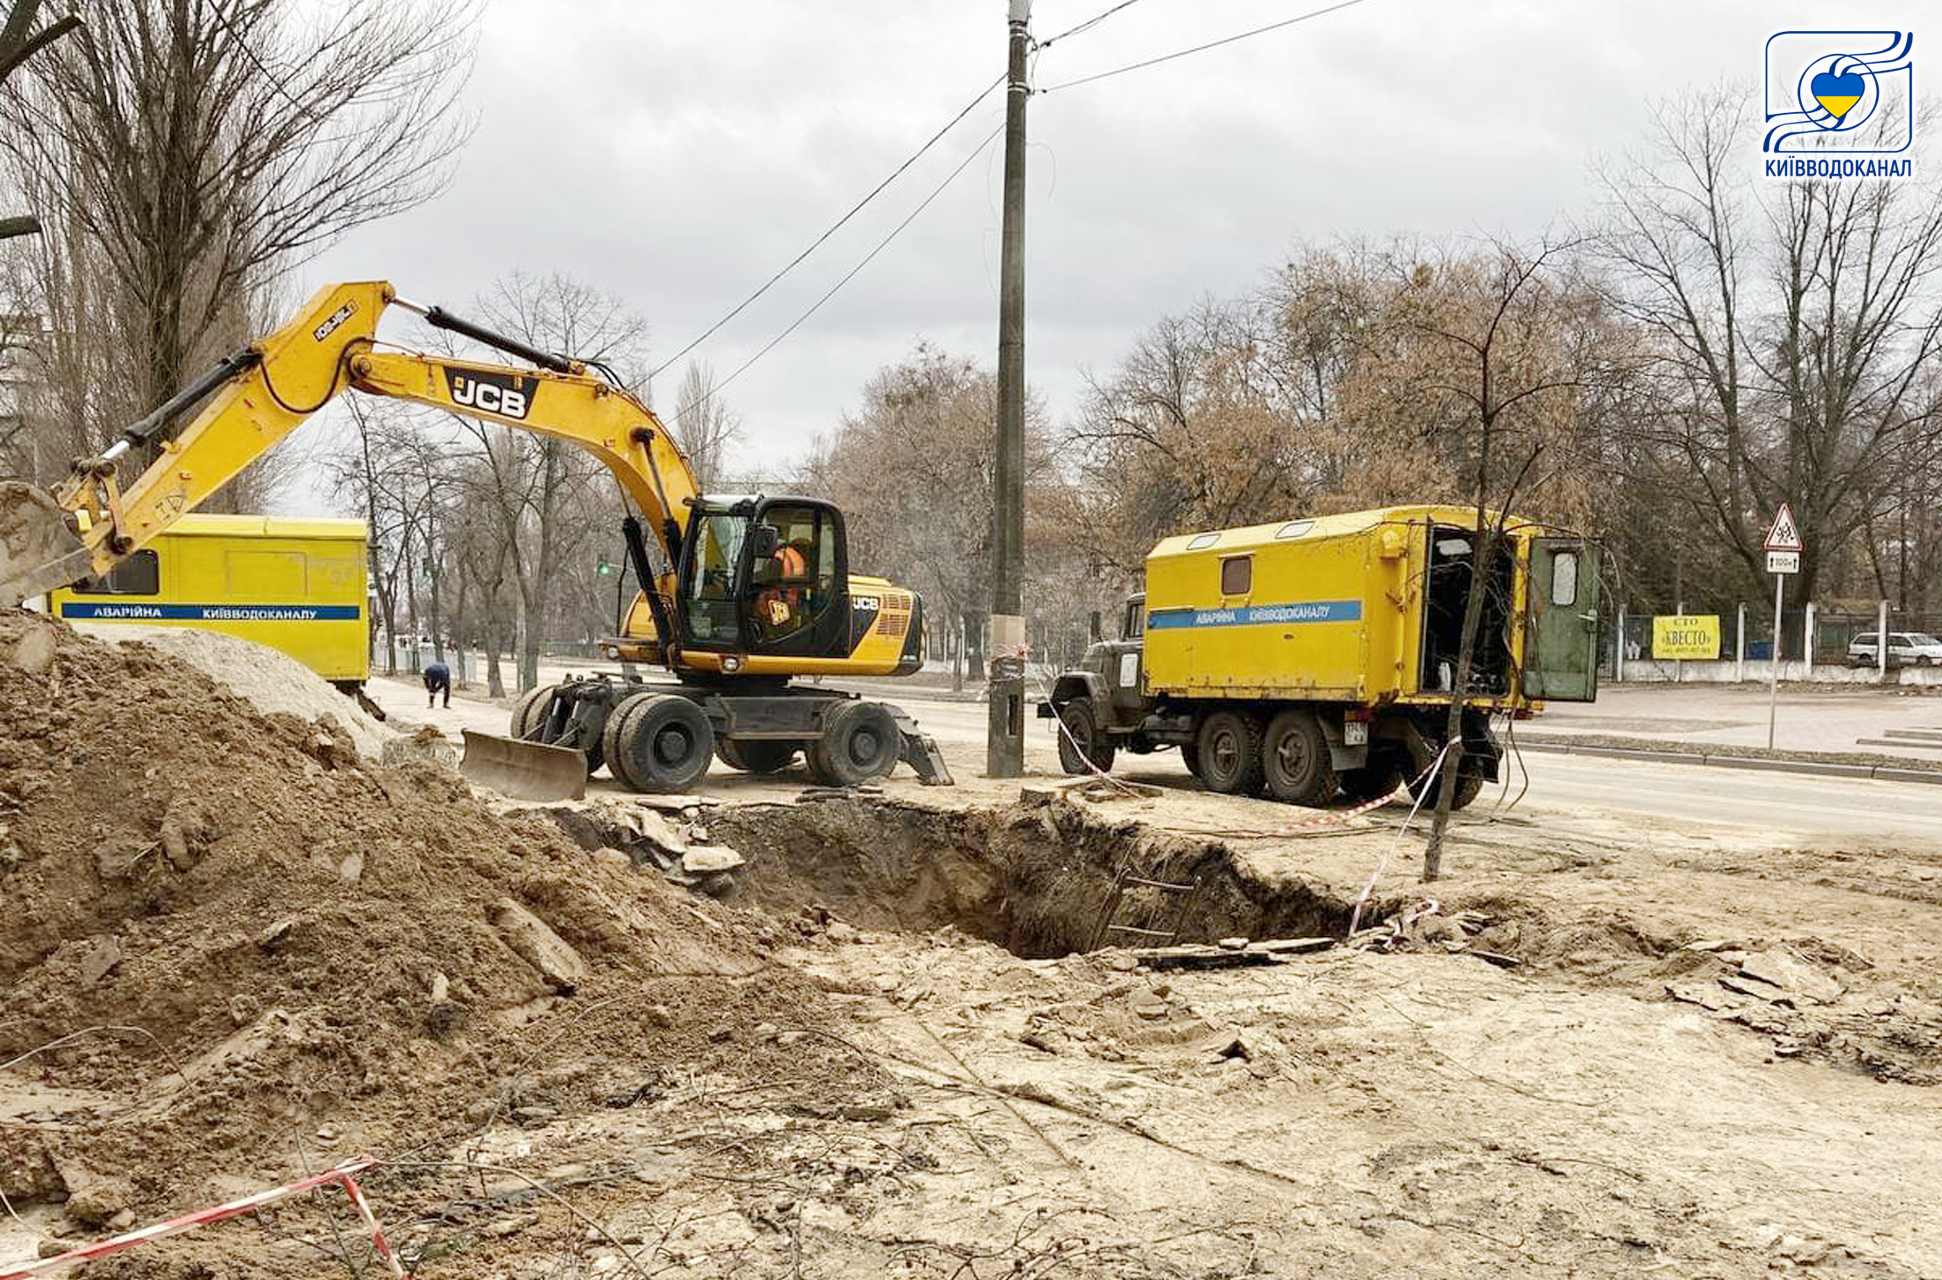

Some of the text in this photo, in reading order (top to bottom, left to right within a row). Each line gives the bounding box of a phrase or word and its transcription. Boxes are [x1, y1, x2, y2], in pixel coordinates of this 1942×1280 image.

[453, 378, 526, 418] JCB
[851, 596, 879, 611] JCB
[94, 605, 318, 621] АВАРІЙНА КИЇВВОДОКАНАЛУ
